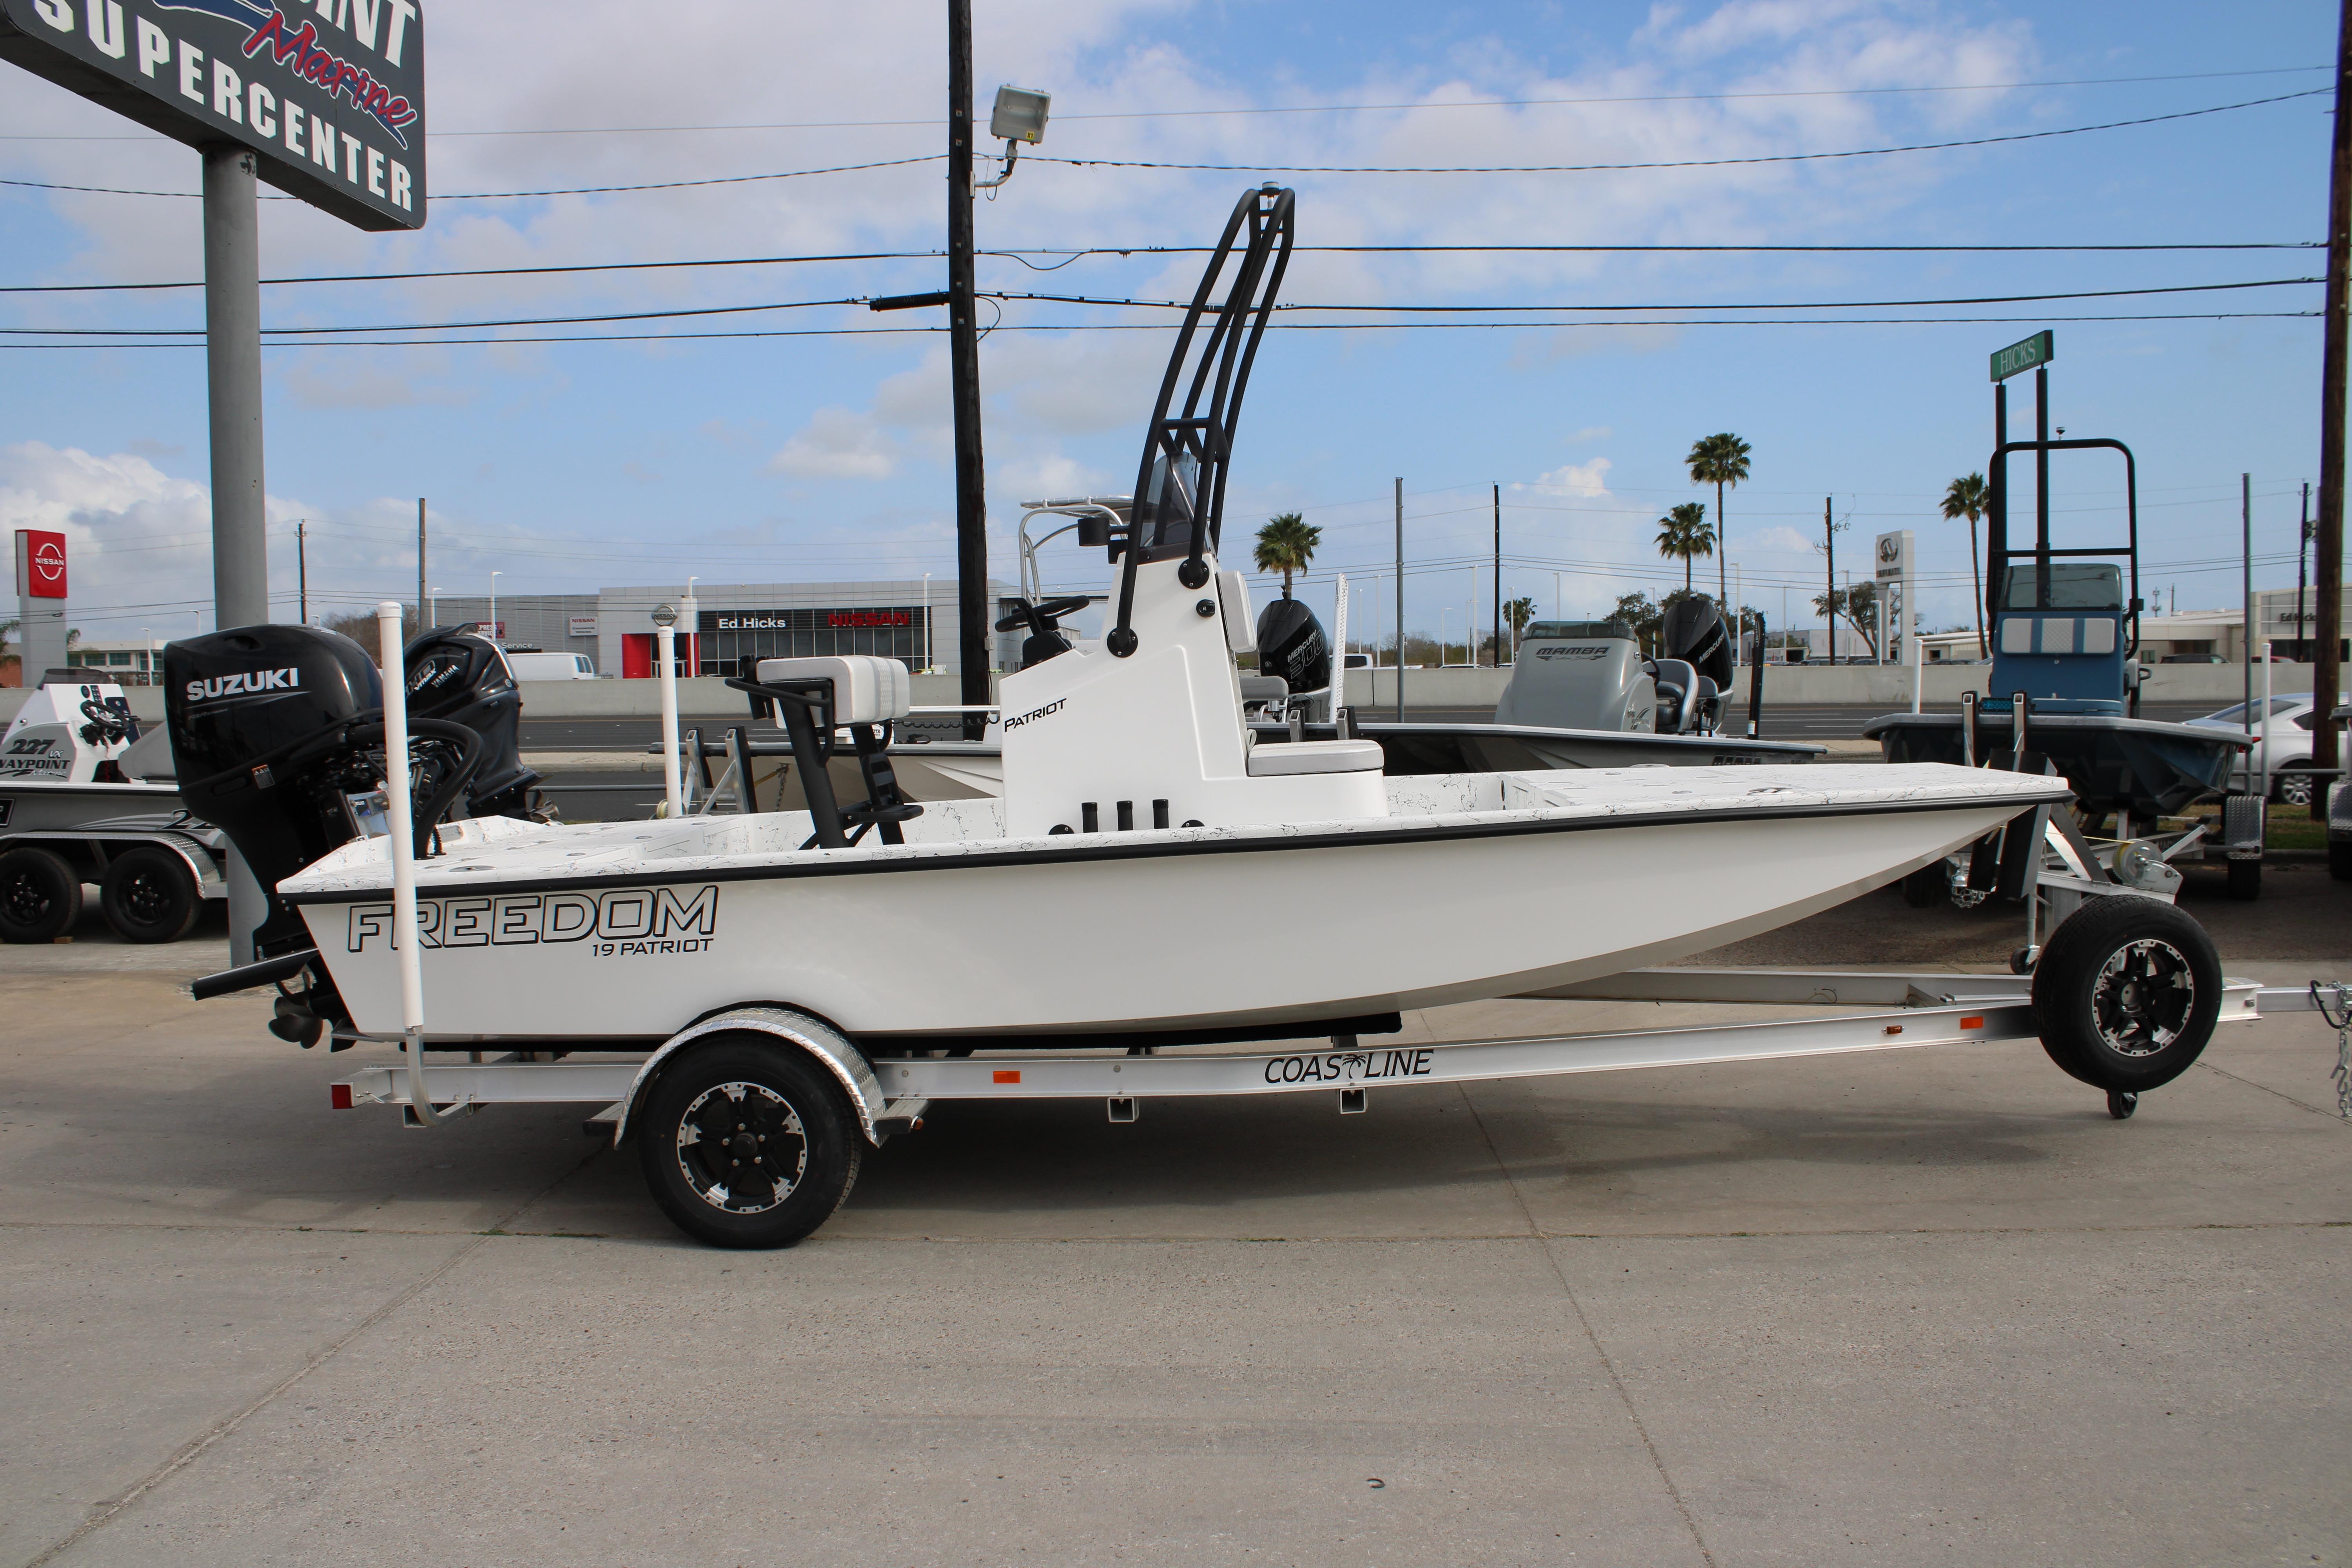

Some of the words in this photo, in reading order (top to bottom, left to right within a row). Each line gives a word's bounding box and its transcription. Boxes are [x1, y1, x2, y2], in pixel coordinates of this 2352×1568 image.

[243, 11, 417, 125] Marine
[2000, 340, 2036, 374] HICKS
[35, 557, 64, 566] NISSAN
[719, 618, 738, 629] Ed
[743, 617, 786, 628] Hicks
[828, 612, 909, 626] NISSAN
[1287, 629, 1316, 663] MERCURY
[1699, 631, 1724, 664] MERCURY
[187, 667, 299, 701] SUZUKI
[431, 664, 460, 688] YAMAHA
[1004, 697, 1067, 733] PATRIOT
[5, 739, 57, 755] 227
[348, 885, 719, 953] FREEDOM
[592, 944, 615, 957] 19
[620, 938, 714, 956] PATRIOT
